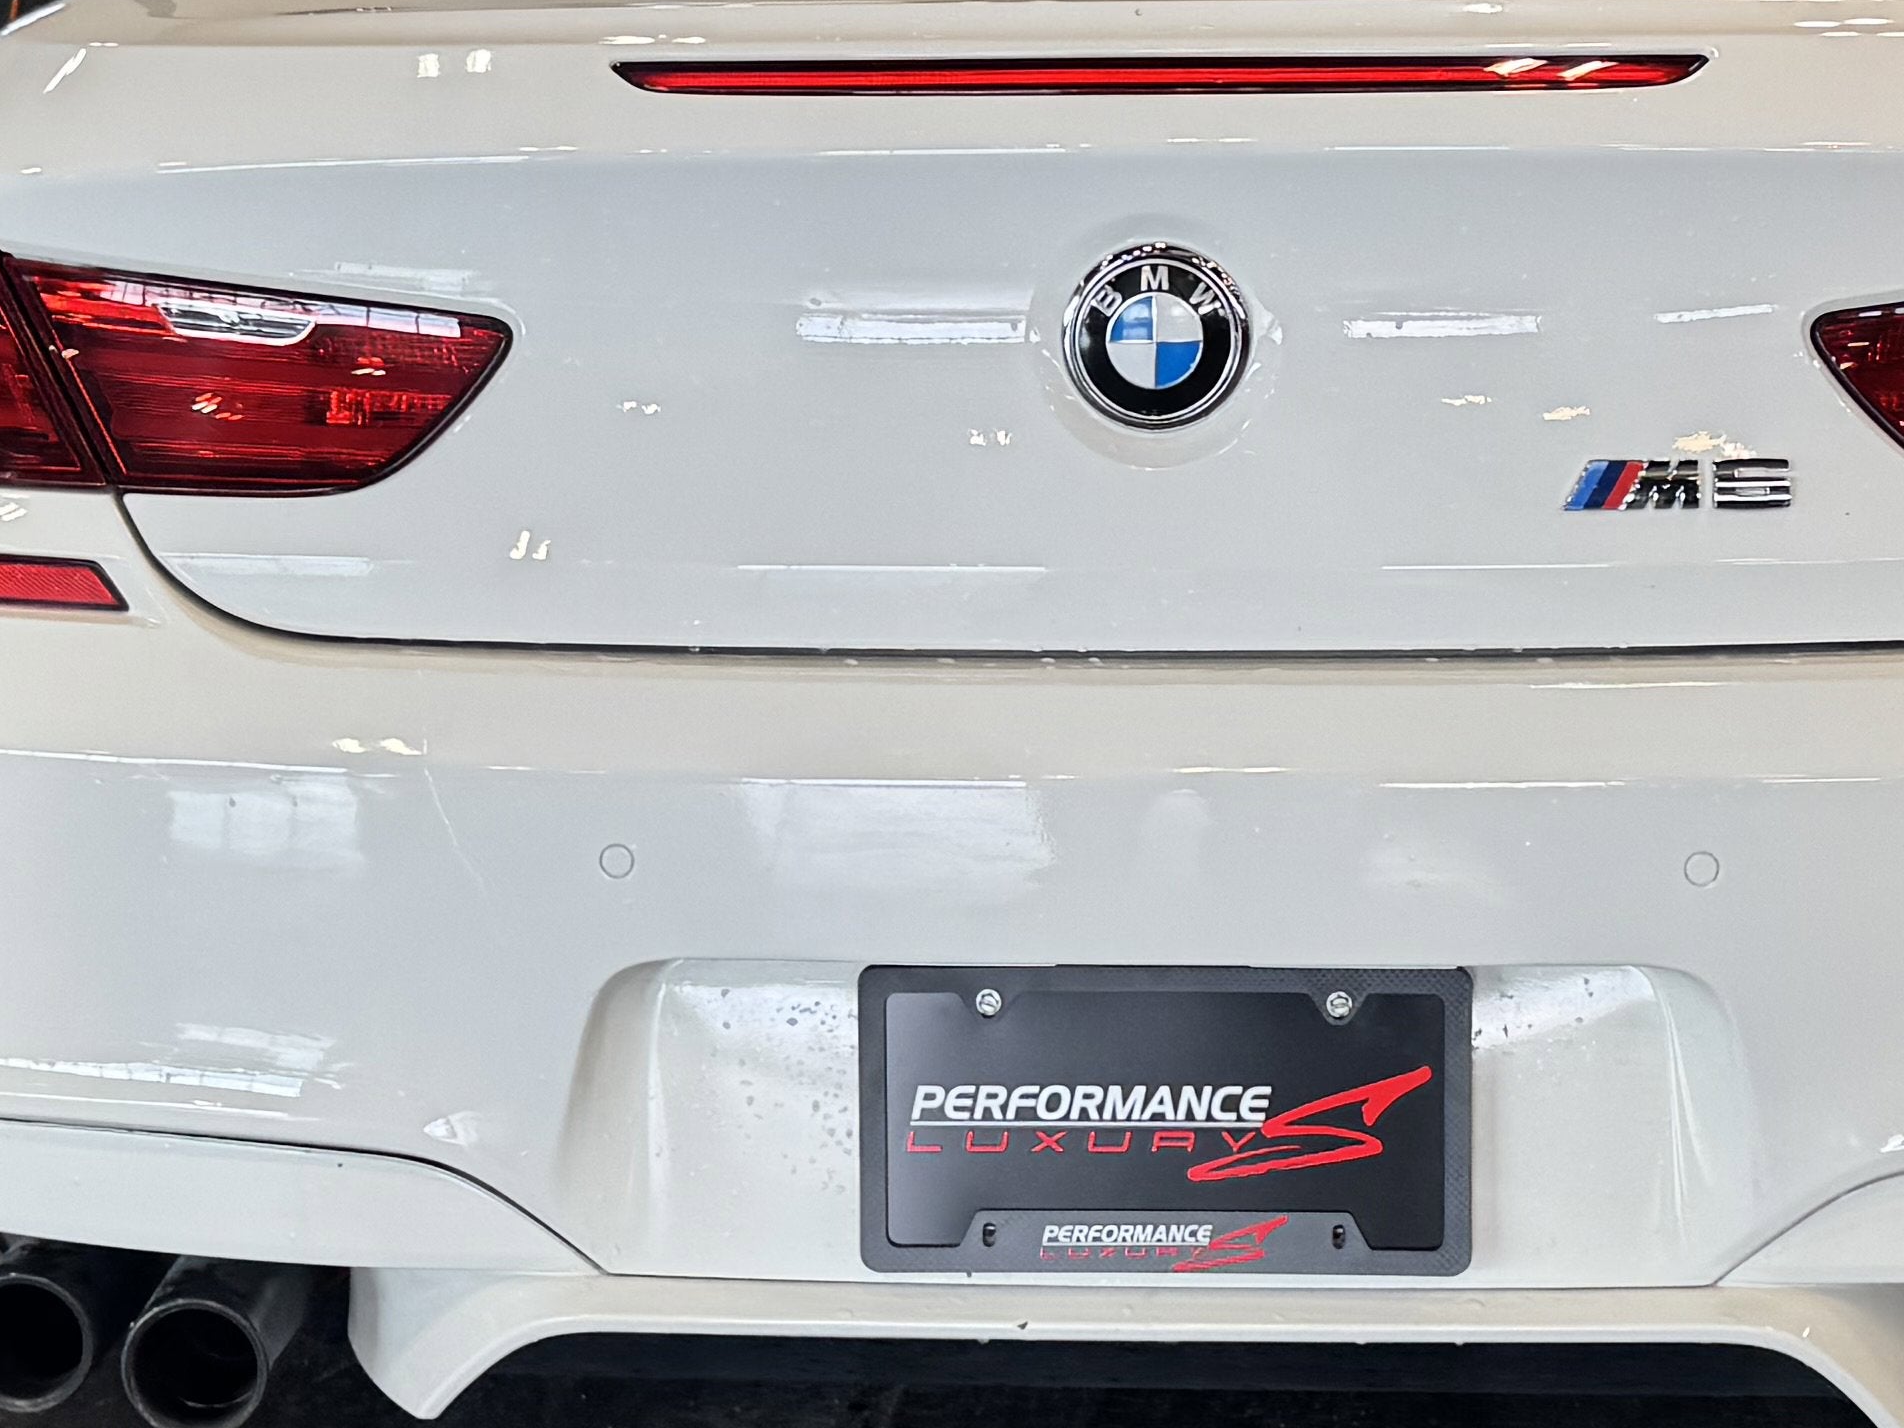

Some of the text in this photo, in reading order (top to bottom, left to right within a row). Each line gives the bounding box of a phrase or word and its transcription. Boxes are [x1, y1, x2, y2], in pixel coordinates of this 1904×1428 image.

[1090, 264, 1222, 318] BMW
[1616, 458, 1793, 510] M6
[910, 1084, 1274, 1122] PERFORMANCE
[906, 1129, 1257, 1154] LUXURY
[1042, 1224, 1214, 1244] PERFORMANCE
